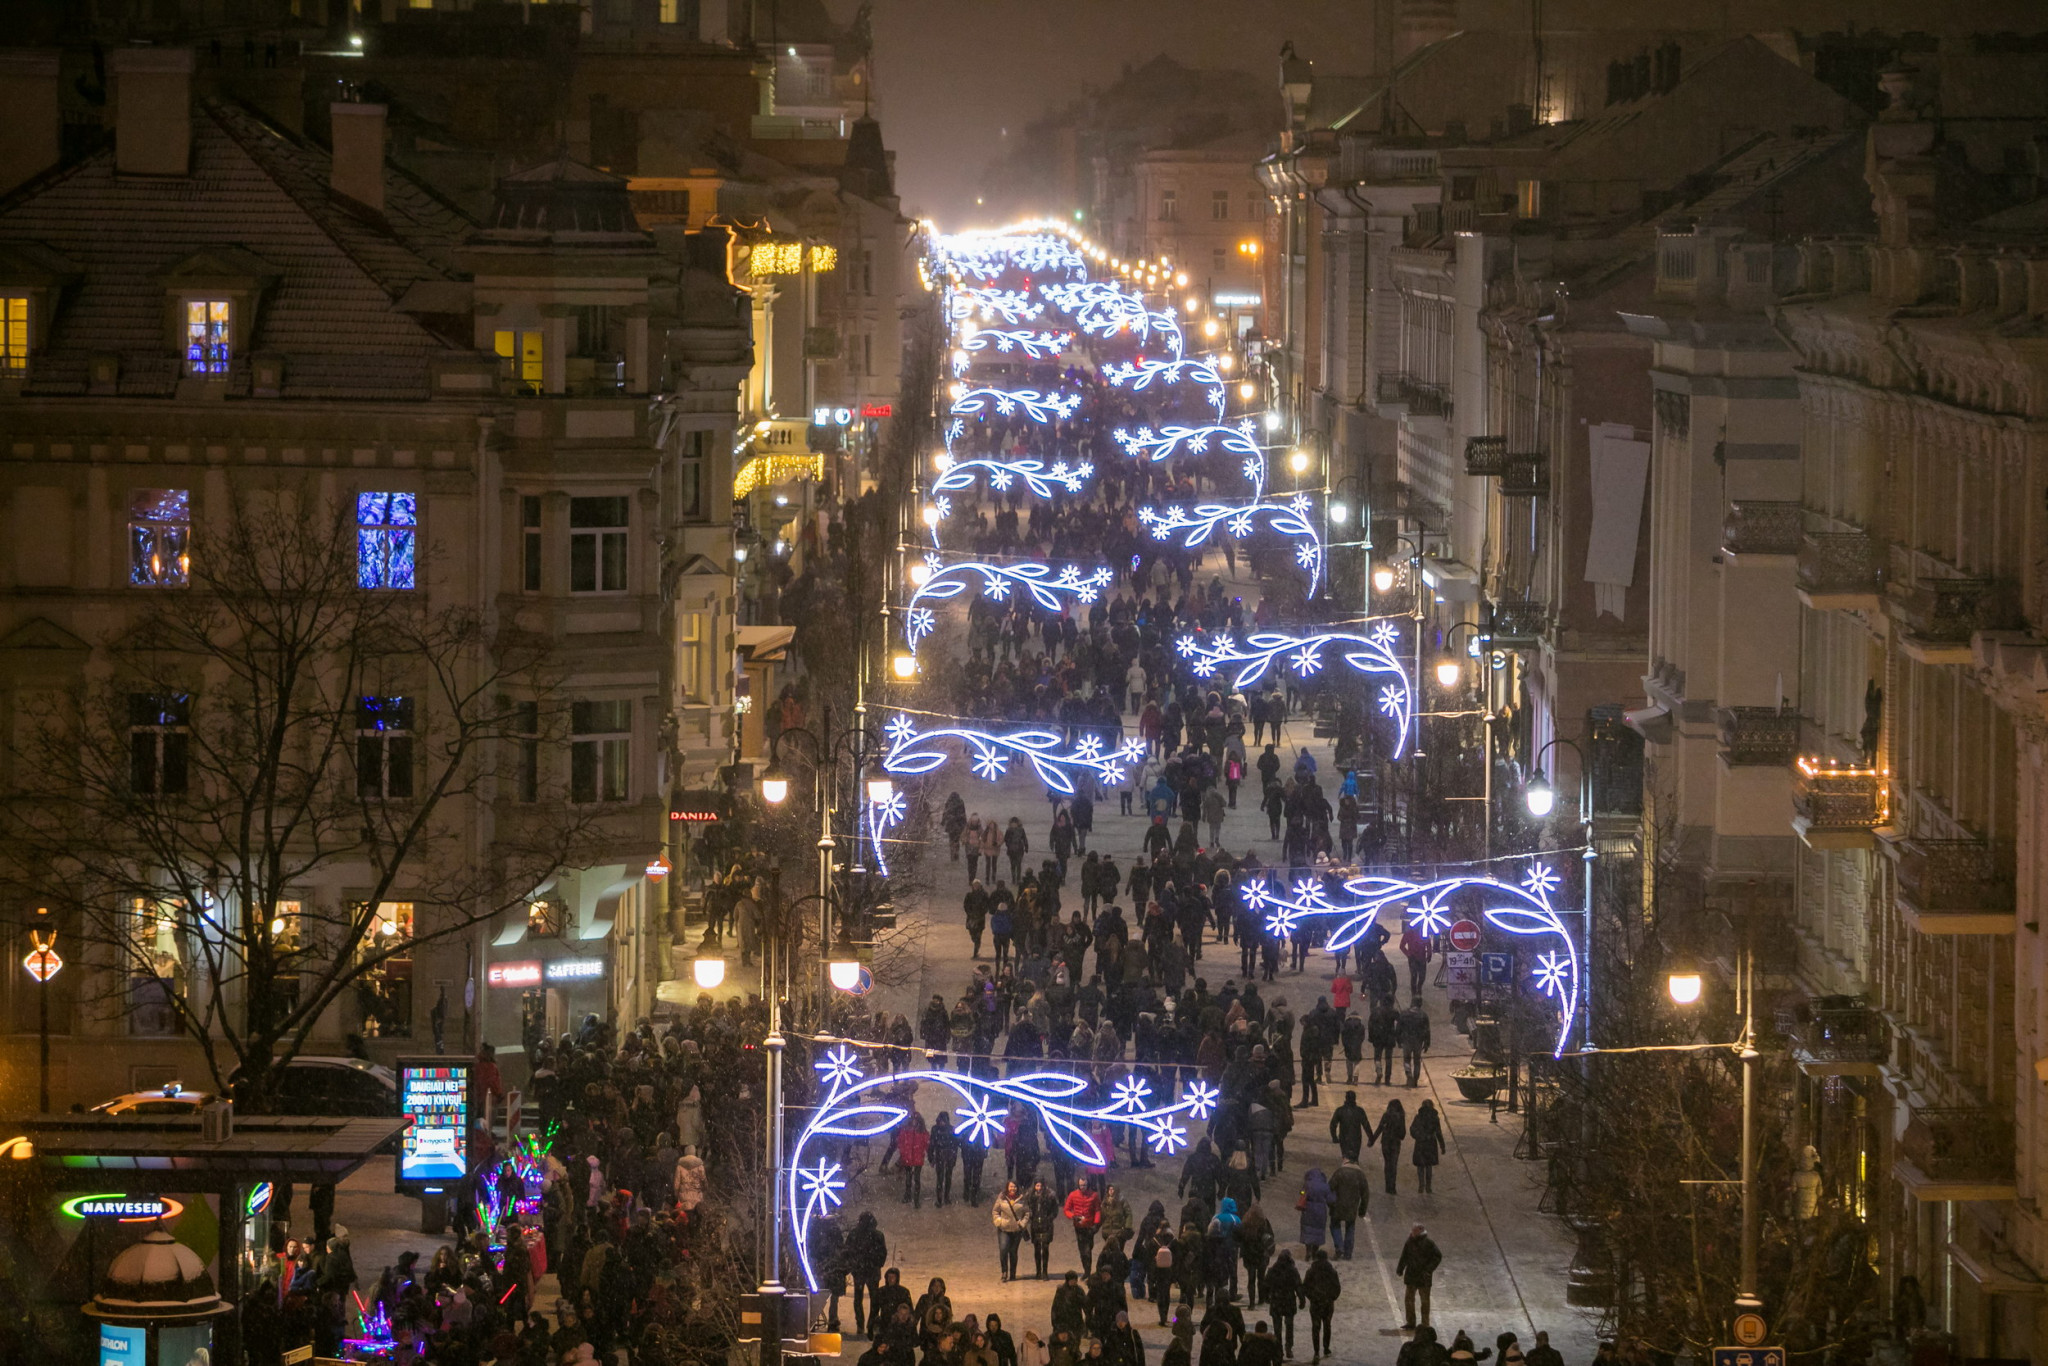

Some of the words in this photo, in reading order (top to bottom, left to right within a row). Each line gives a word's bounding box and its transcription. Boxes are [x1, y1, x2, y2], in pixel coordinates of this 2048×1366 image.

[670, 812, 717, 820] DANIJA
[548, 961, 602, 977] CAFFEINE
[1488, 956, 1506, 981] P
[406, 1095, 432, 1105] 20000
[82, 1202, 163, 1214] NARVESEN
